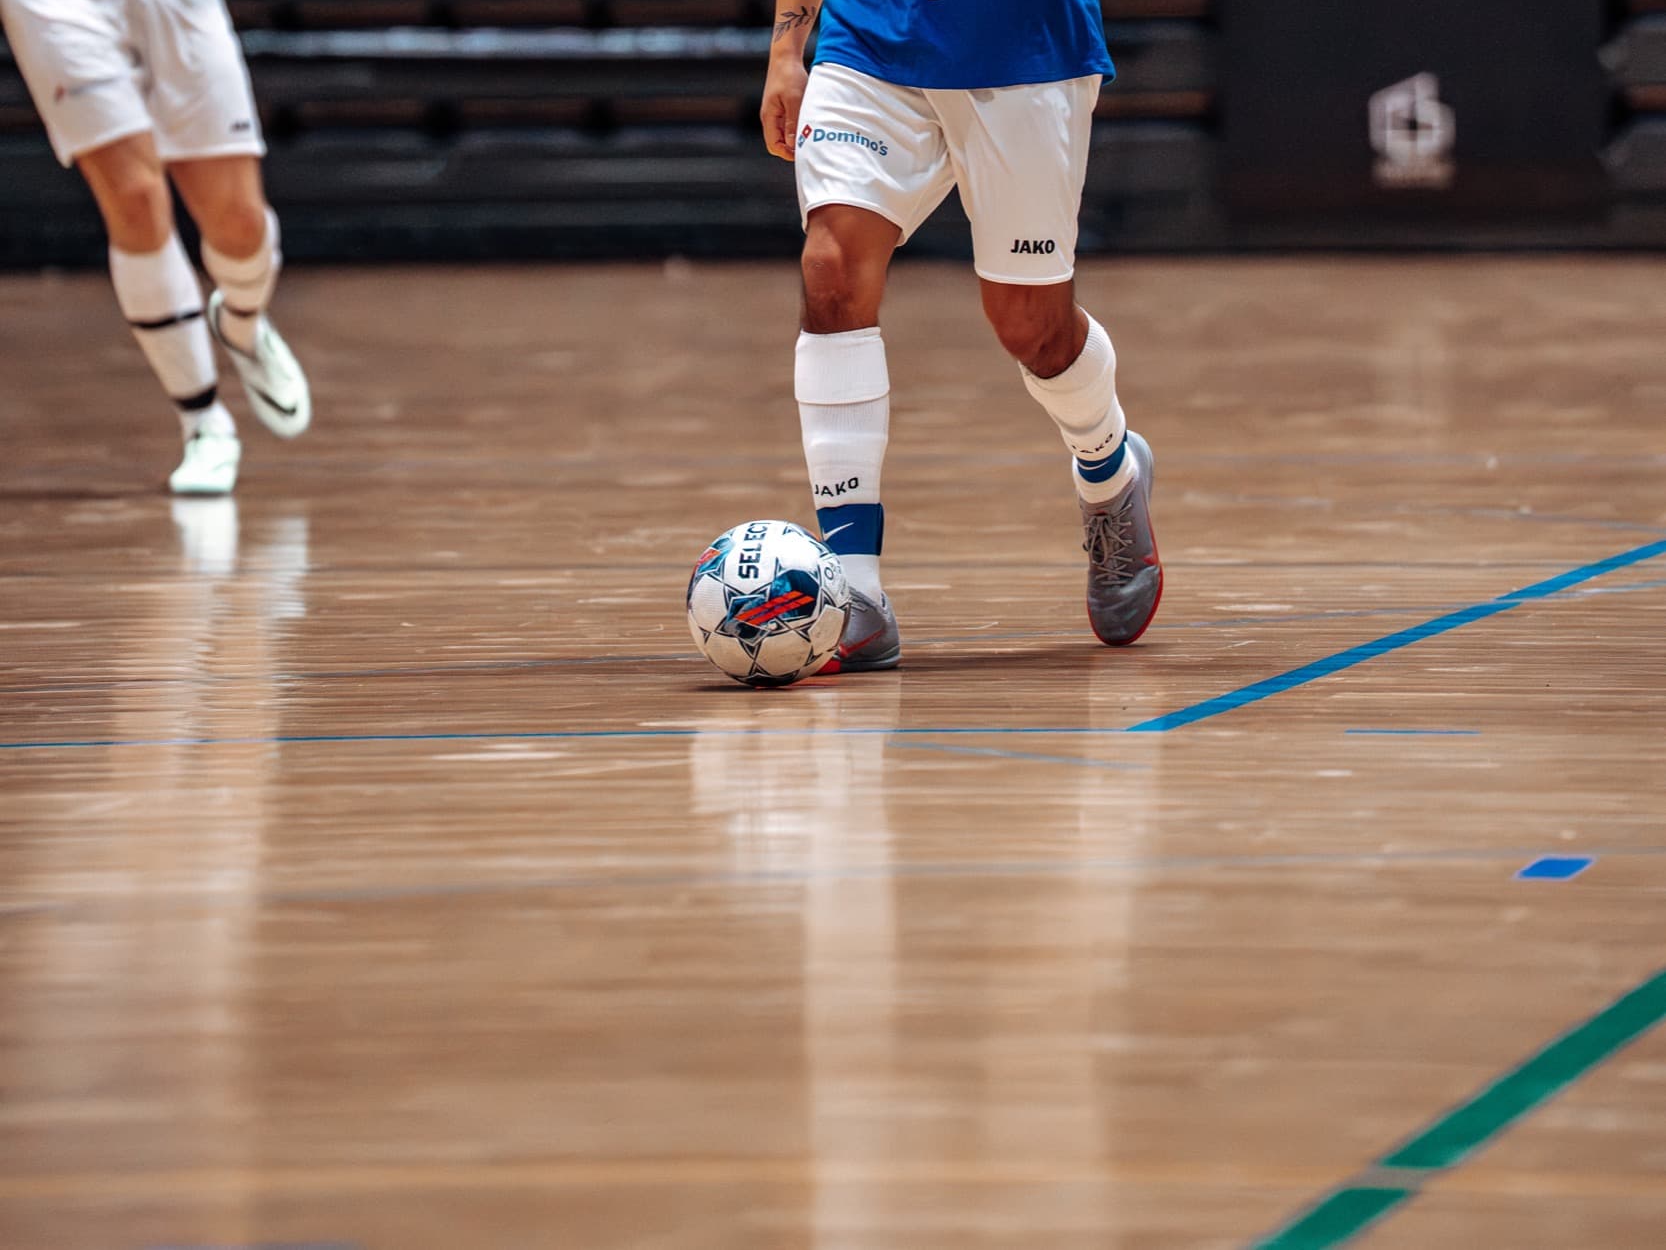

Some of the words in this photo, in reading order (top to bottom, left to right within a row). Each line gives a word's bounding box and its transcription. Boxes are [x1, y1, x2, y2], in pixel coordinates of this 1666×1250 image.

[813, 128, 889, 156] Domino's
[1010, 239, 1056, 254] JAKO
[814, 476, 860, 497] JAKO
